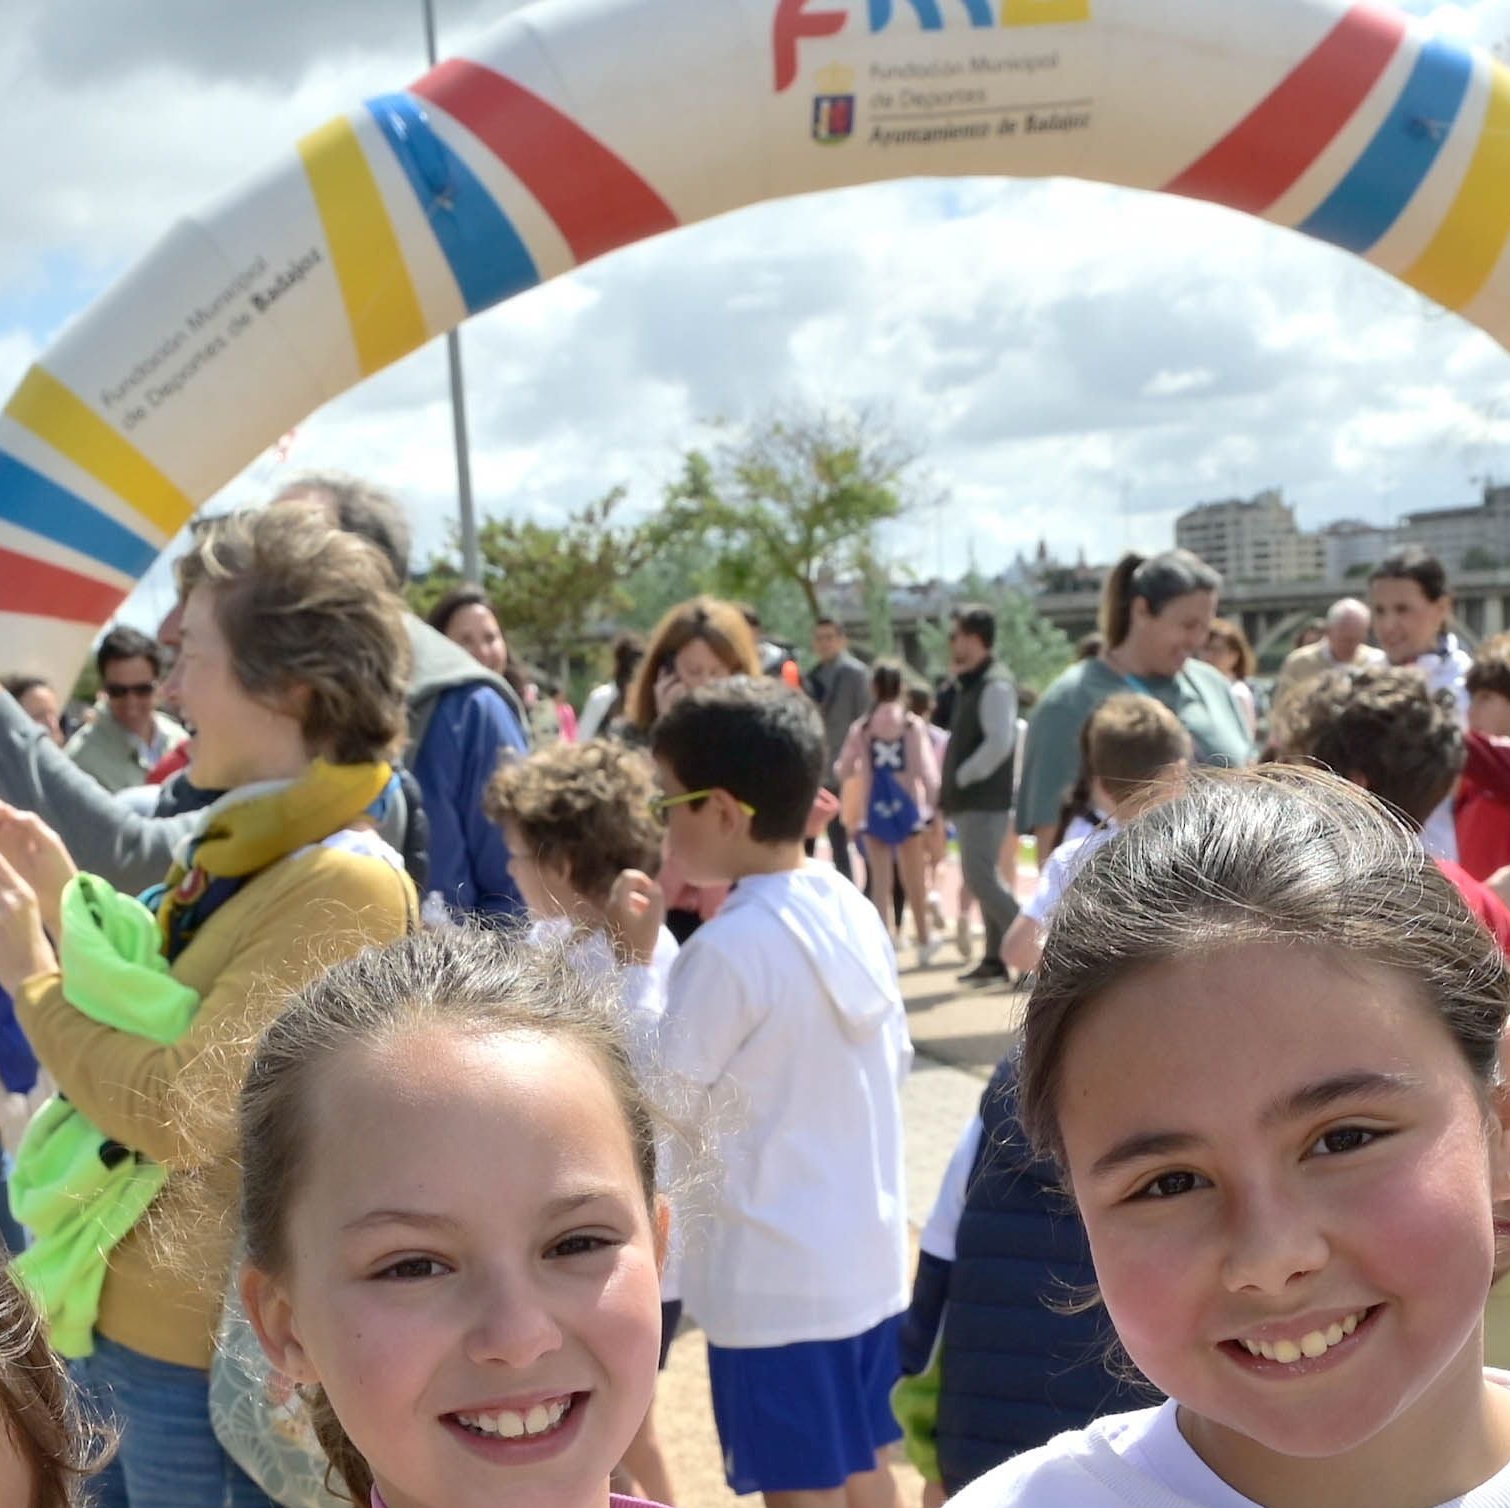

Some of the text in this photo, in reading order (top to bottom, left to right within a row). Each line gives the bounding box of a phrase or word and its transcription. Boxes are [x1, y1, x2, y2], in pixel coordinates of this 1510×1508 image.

[970, 51, 1061, 77] Municipal
[869, 86, 988, 110] de Deportes
[868, 110, 1092, 149] Ayuntamiento de Badajoz
[99, 254, 268, 409] Fundación Municipal
[121, 246, 324, 431] de Deportes de Badajoz
